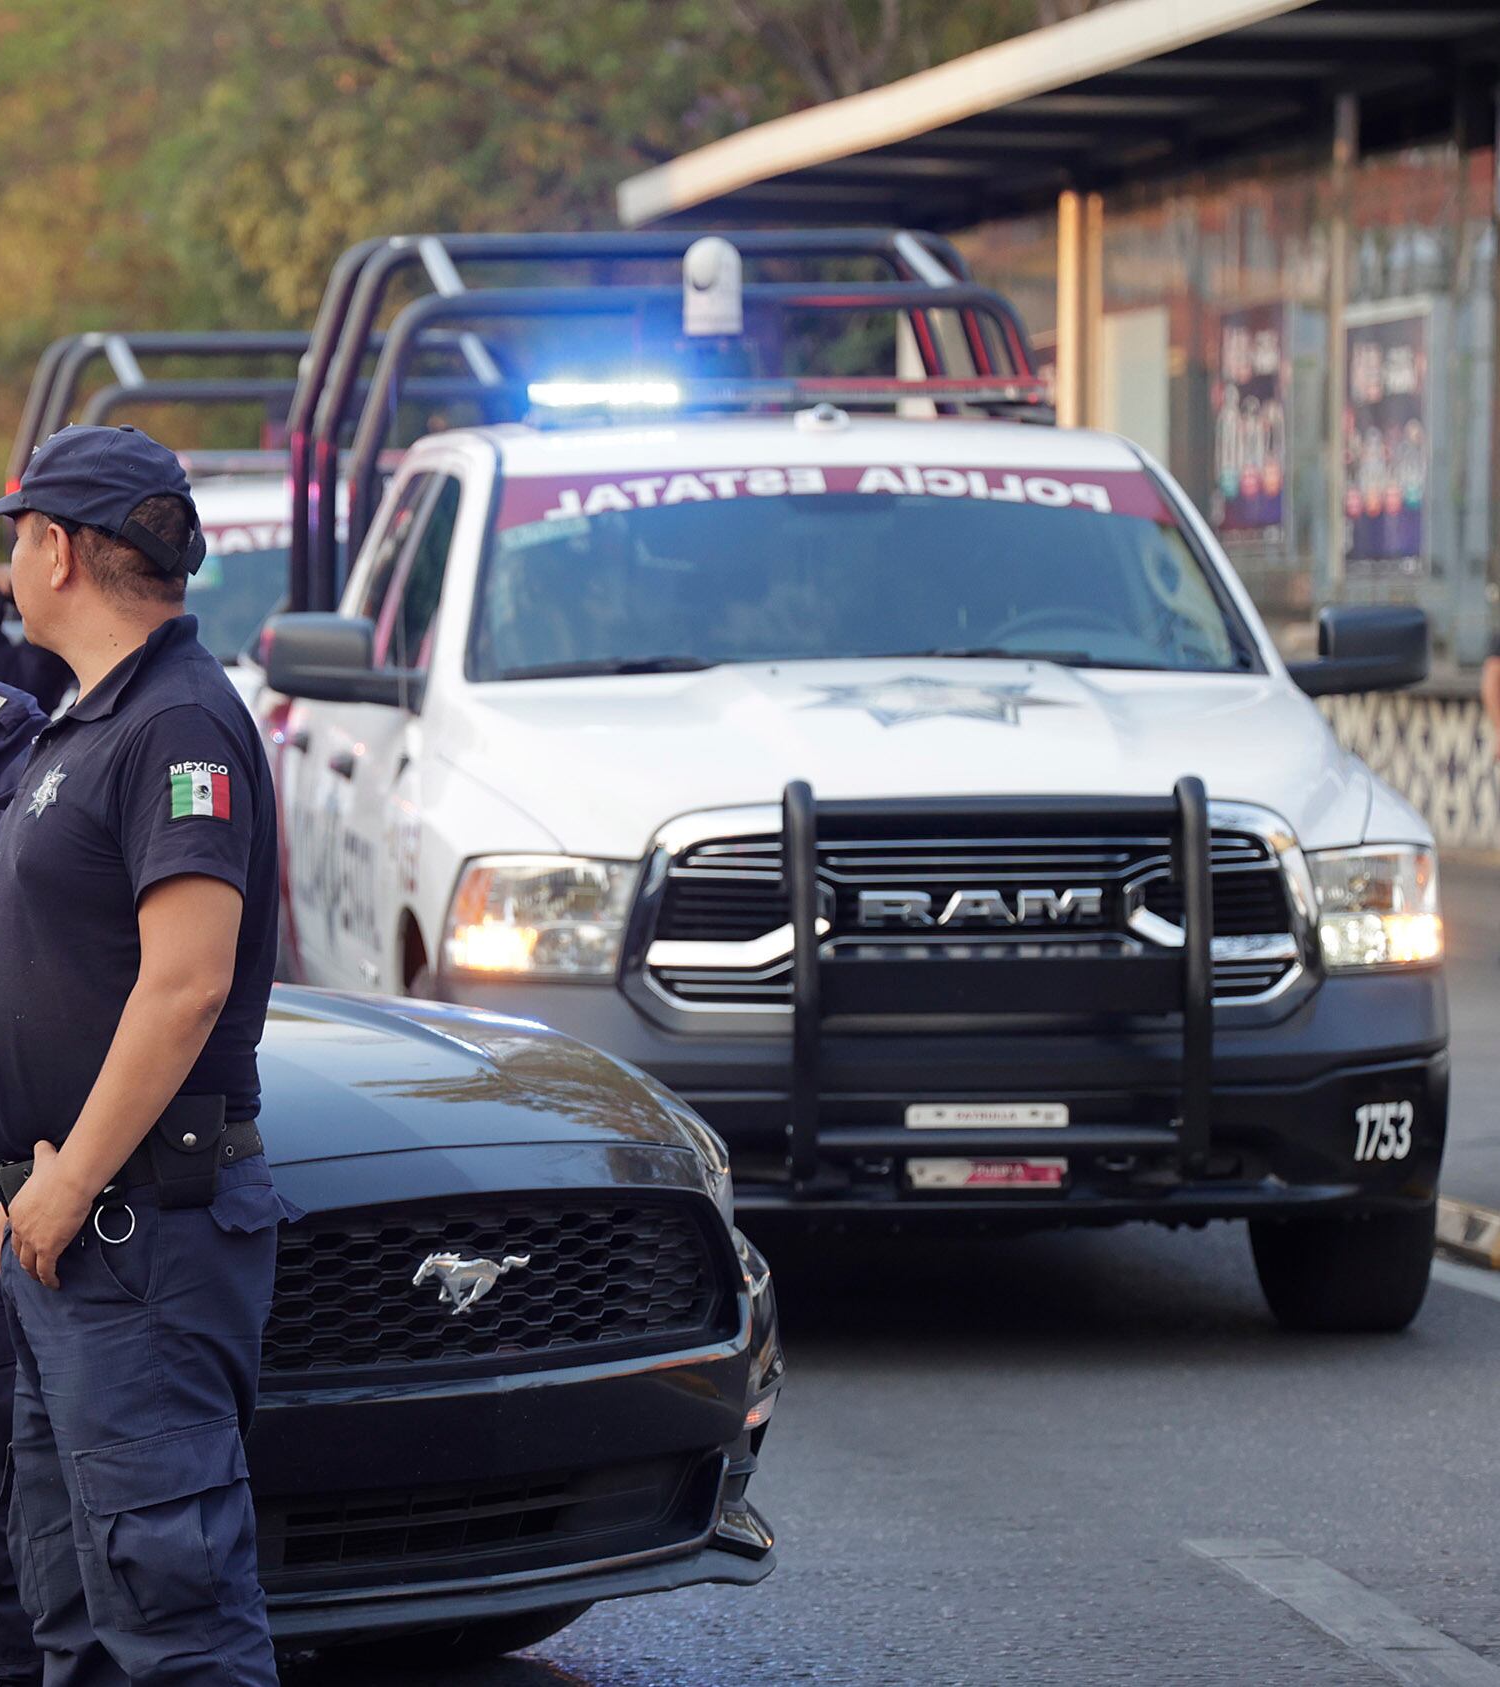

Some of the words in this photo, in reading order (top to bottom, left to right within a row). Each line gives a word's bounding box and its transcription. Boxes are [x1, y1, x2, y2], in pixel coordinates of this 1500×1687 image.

[169, 761, 228, 775] MÉXICO
[858, 888, 1103, 927] RAM
[1354, 1100, 1414, 1161] 1753
